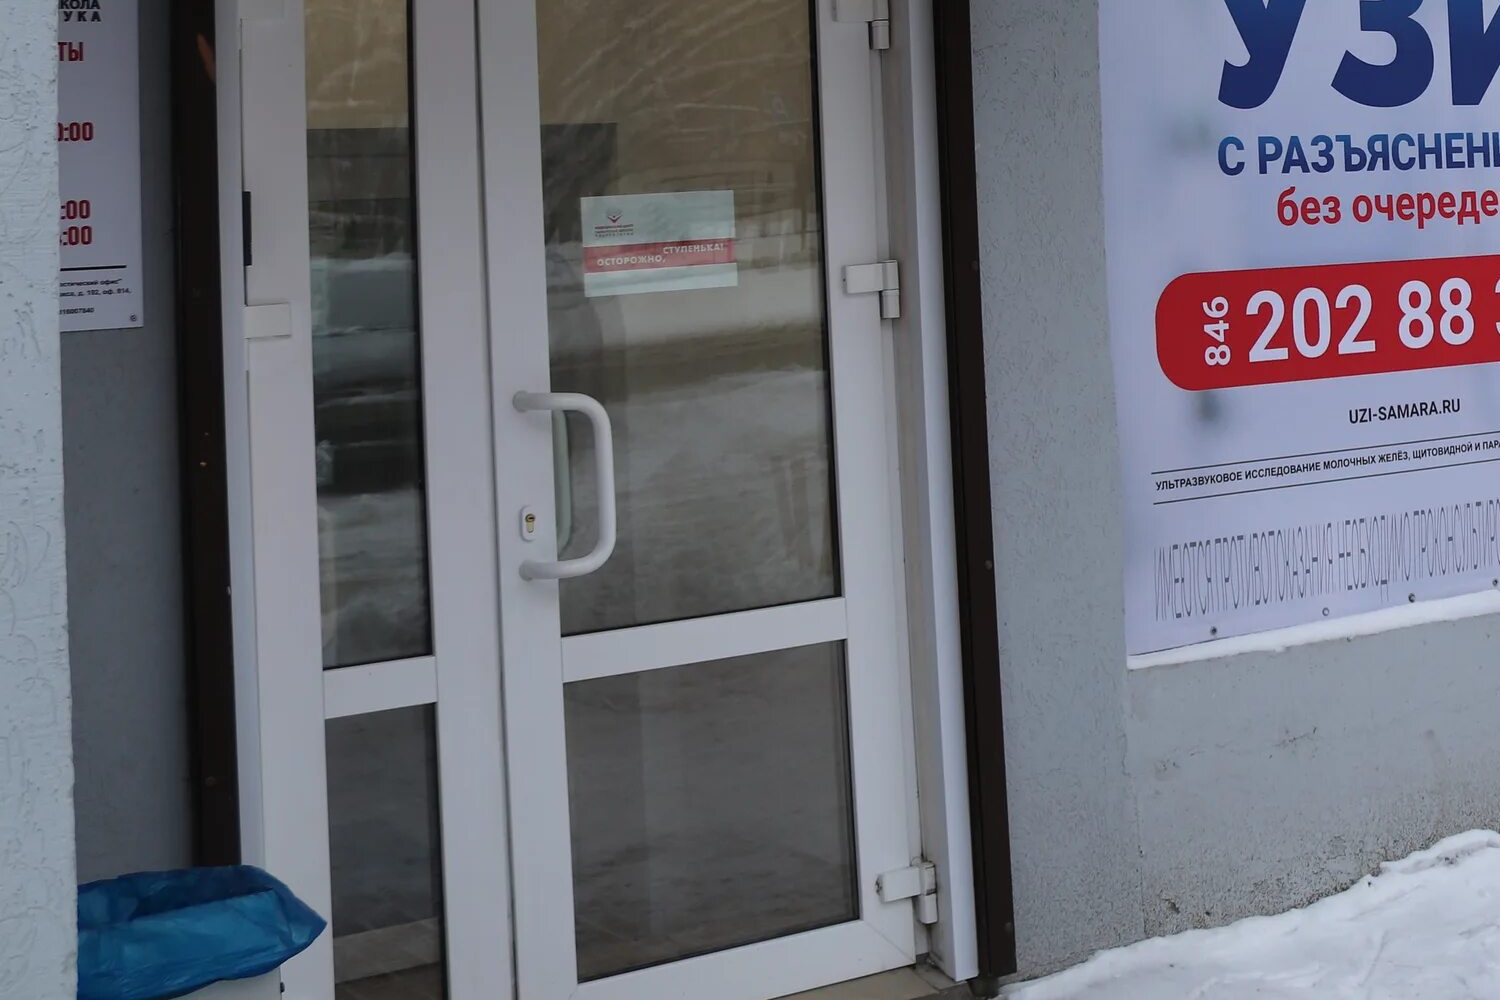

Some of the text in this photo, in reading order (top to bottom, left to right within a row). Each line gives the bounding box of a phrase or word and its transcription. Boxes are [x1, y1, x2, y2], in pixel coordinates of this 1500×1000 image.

[58, 0, 101, 9] КОЛА
[1217, 135, 1246, 177] С
[1276, 185, 1342, 227] без
[597, 243, 725, 267] ОСТОРОЖНО, СТУПЕНЬКА!
[1202, 296, 1231, 366] 846
[1246, 284, 1376, 363] 202
[1398, 277, 1475, 349] 88
[1348, 398, 1461, 425] UZI-SAMARA.RU
[1155, 471, 1243, 491] УЛЬТРАЗВУКОВОЕ
[1244, 461, 1321, 480] ИССЛЕДОВАНИЕ
[1323, 455, 1376, 470] МОЛОЧНЫХ
[1412, 441, 1473, 460] ЩИТОВИДНОЙ
[1474, 440, 1481, 451] И
[1153, 539, 1213, 621] ИМЕЮТСЯ
[1337, 511, 1411, 602] НЕОБХОДИМО
